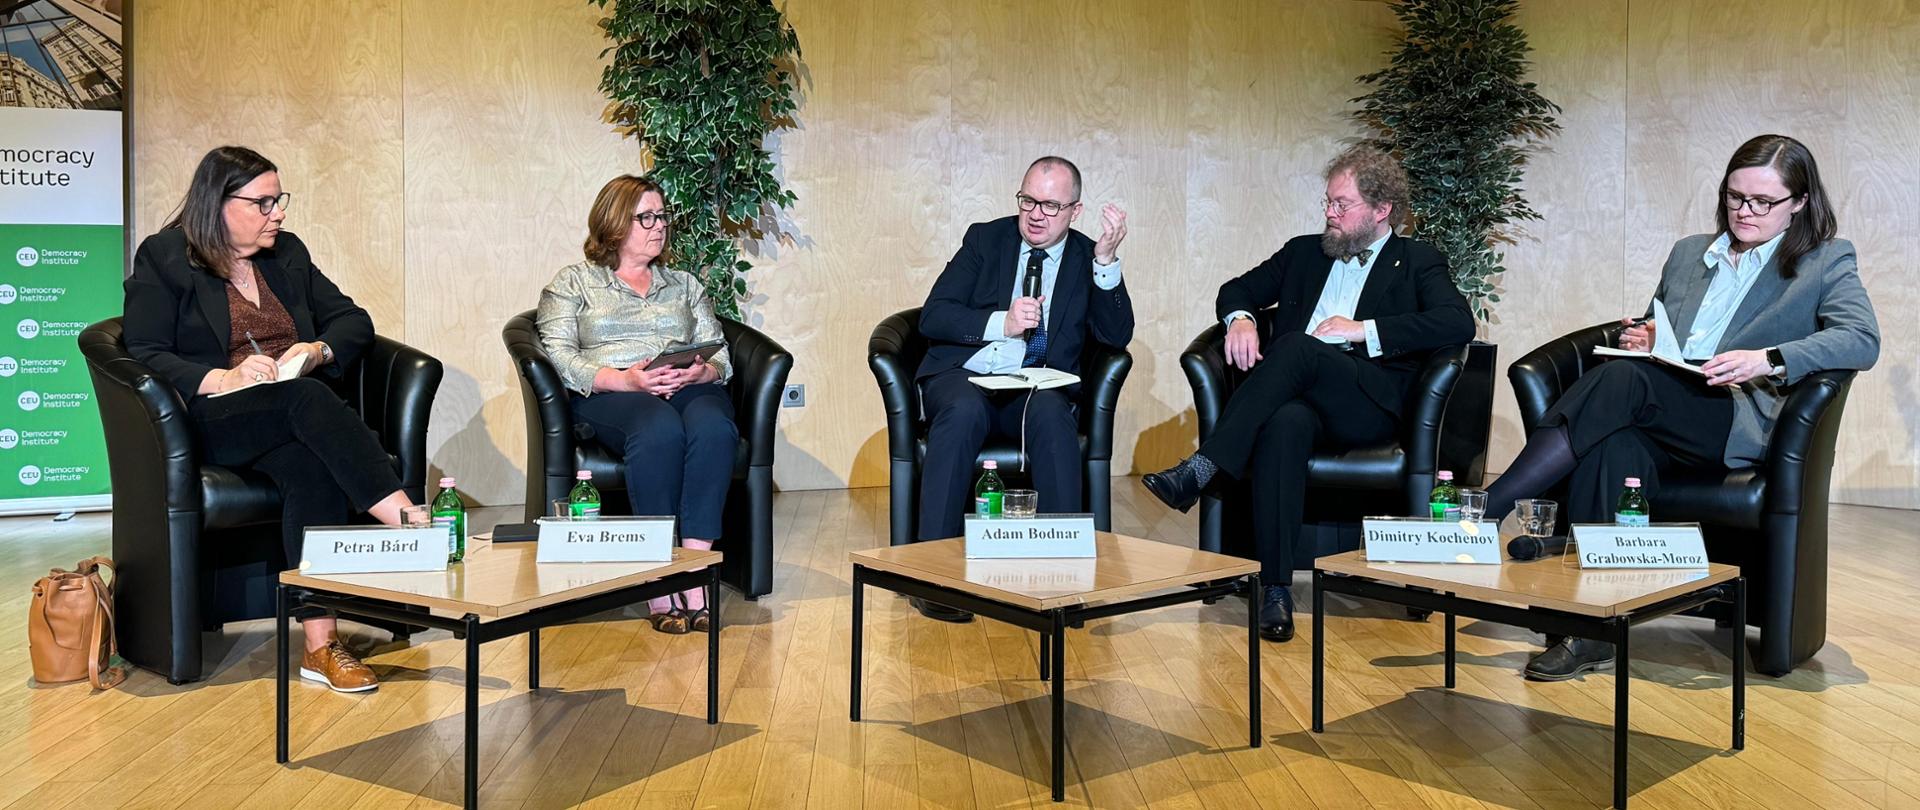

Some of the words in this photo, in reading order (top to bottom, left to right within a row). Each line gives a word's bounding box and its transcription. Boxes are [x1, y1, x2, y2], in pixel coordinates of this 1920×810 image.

[18, 252, 36, 261] CEU
[41, 249, 87, 258] Democracy
[41, 257, 79, 265] Institute
[20, 286, 66, 296] Democracy
[19, 324, 37, 333] CEU
[42, 321, 88, 329] Democracy
[20, 358, 67, 367] Democracy
[20, 366, 59, 374] Institute
[20, 396, 39, 405] CEU
[43, 391, 89, 401] Democracy
[43, 400, 81, 408] Institute
[0, 434, 17, 442] CEU
[21, 429, 68, 439] Democracy
[21, 438, 60, 446] Institute
[44, 465, 90, 475] Democracy
[21, 471, 39, 480] CEU
[44, 474, 81, 482] Institute
[567, 531, 596, 544] Eva
[599, 529, 646, 543] Brems
[982, 528, 1024, 540] Adam
[1028, 527, 1080, 540] Bodnar
[1368, 530, 1423, 546] Dimitry
[1426, 531, 1495, 545] Kochenov
[333, 540, 376, 555] Petra
[379, 538, 419, 554] Bárd
[1614, 536, 1667, 548] Barbara
[1586, 552, 1703, 566] Grabowska-Moroz
